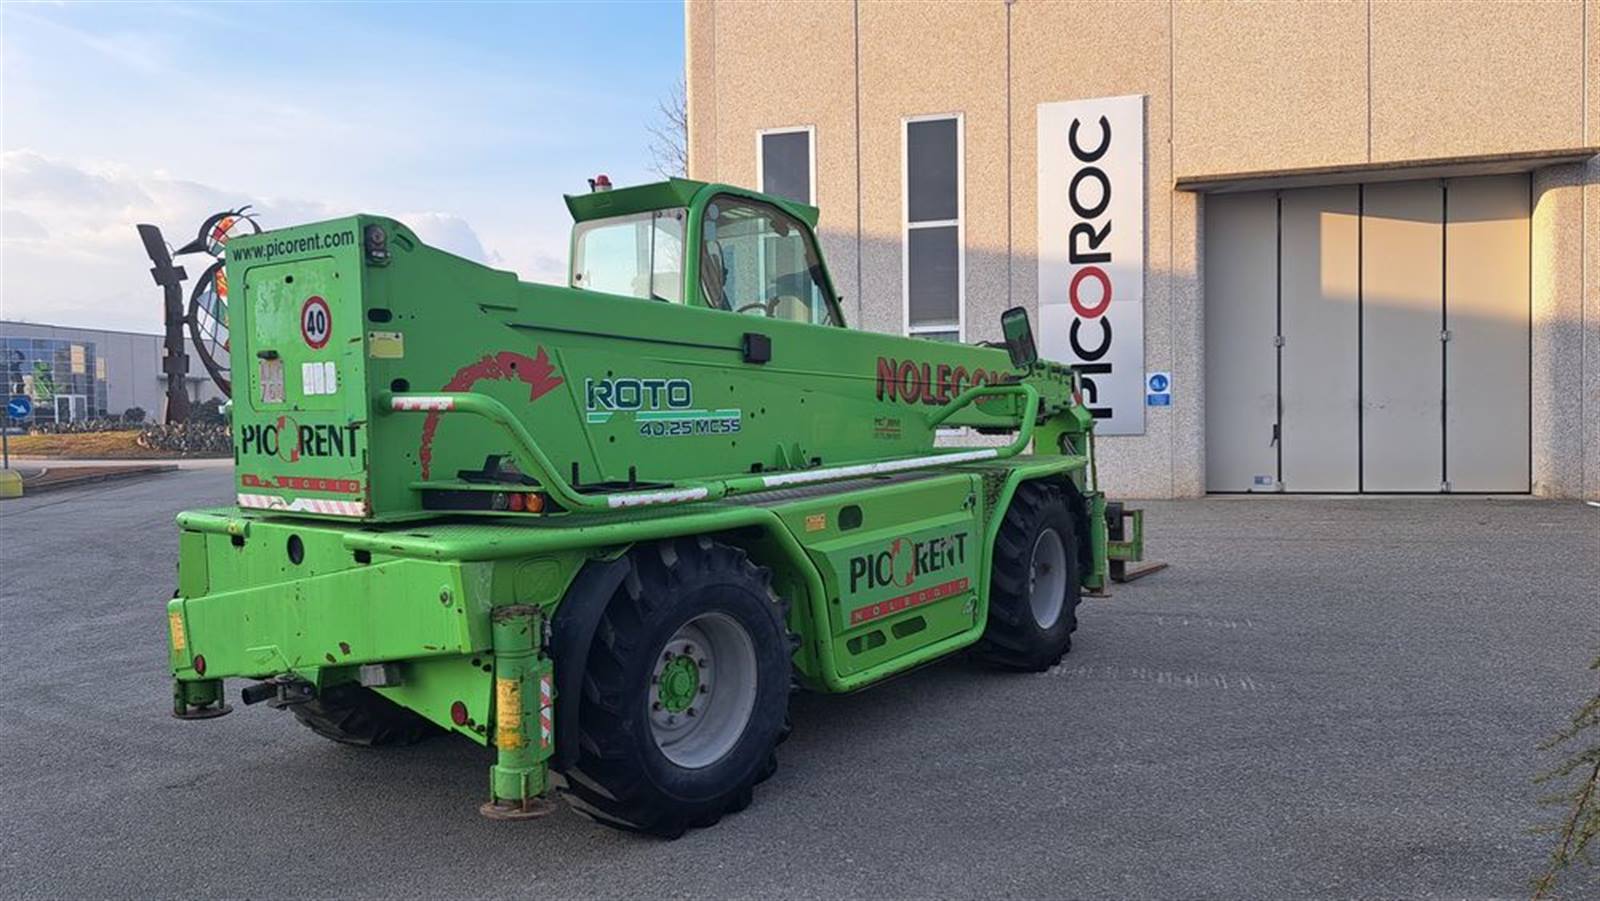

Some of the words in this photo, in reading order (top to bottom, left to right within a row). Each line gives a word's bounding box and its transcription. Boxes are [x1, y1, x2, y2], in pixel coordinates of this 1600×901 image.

[232, 230, 355, 261] www.picorent.com
[1068, 115, 1112, 418] PICOROC
[307, 310, 326, 336] 40
[585, 377, 693, 411] ROTO
[241, 415, 361, 462] PICORENT
[640, 421, 692, 437] 40.25
[850, 533, 968, 594] PICORENT
[853, 580, 967, 621] NOLEGGIO
